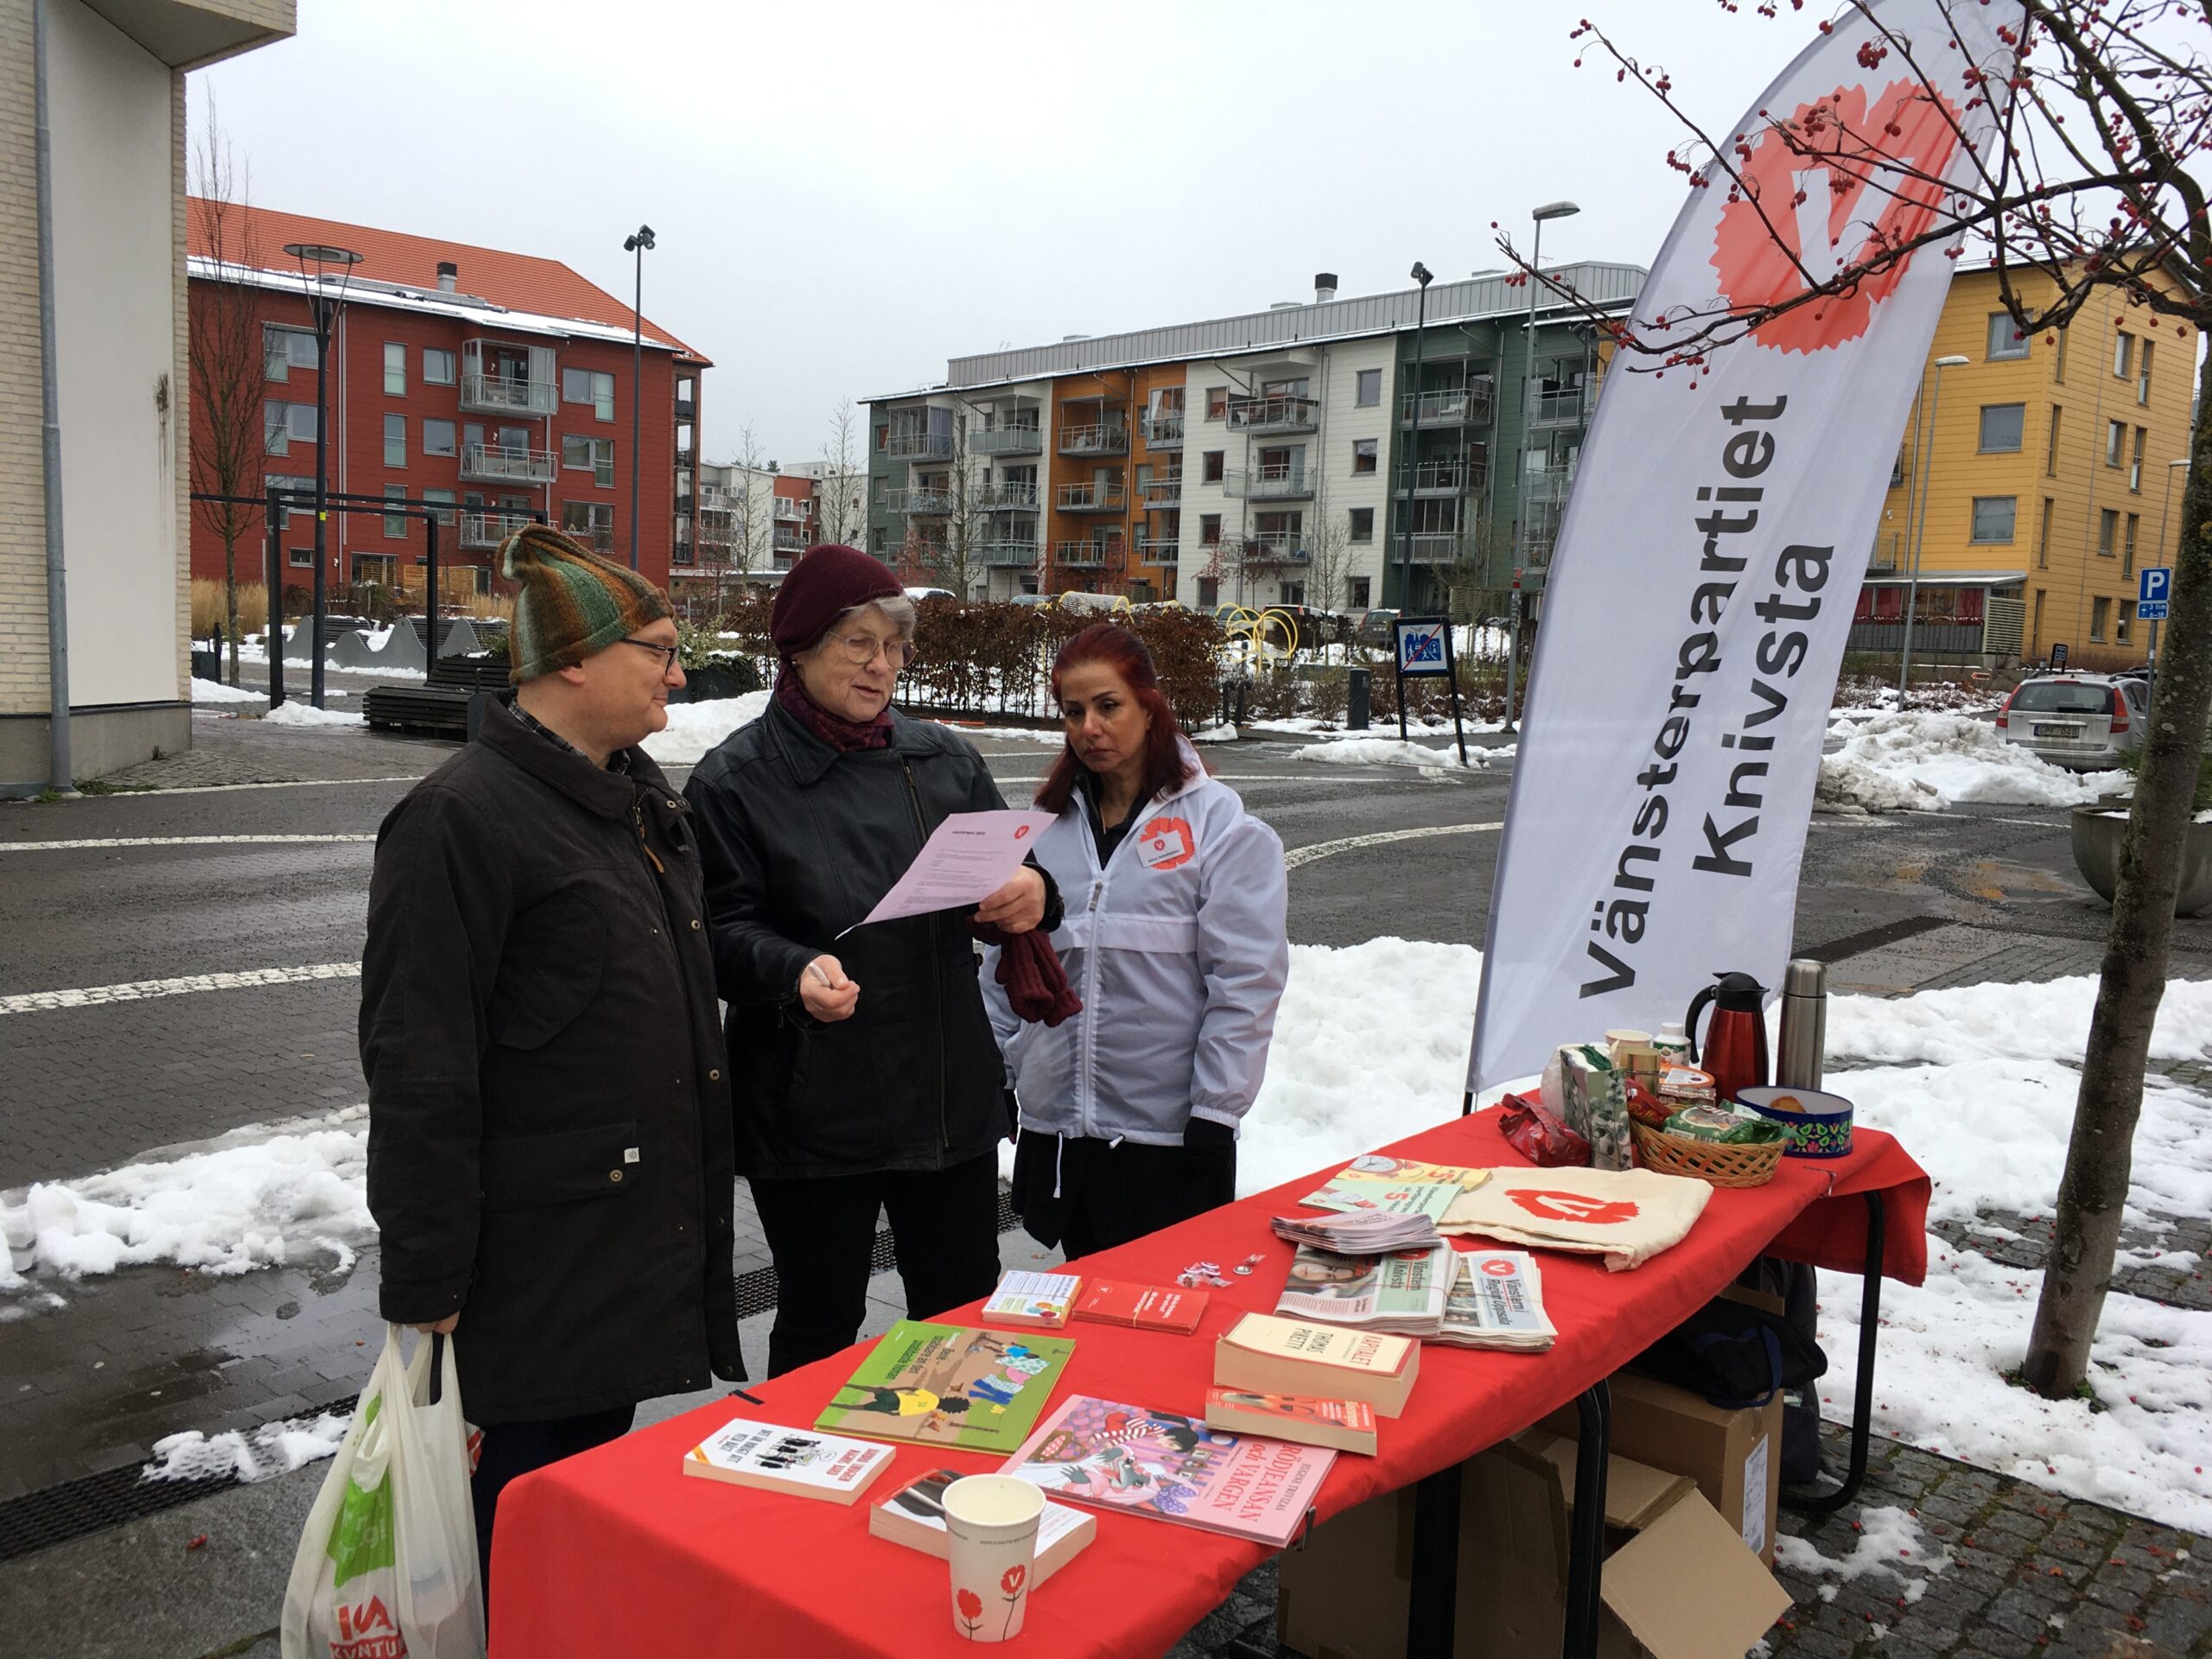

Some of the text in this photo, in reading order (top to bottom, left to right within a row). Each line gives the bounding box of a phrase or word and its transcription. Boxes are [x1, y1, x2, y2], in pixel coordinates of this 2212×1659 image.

[1791, 156, 1916, 289] V
[2146, 571, 2165, 599] P
[1579, 393, 1788, 1000] Vänsterpartiet
[1693, 543, 1834, 877] Knivsta
[1535, 1193, 1608, 1218] V
[1390, 1264, 1408, 1289] Knivsta
[1487, 1262, 1506, 1274] V
[1485, 1278, 1511, 1325] Region Uppsala
[1504, 1278, 1525, 1310] Vänstern
[919, 1335, 945, 1357] snabbare
[1284, 1329, 1313, 1350] PIKETTY
[1306, 1332, 1335, 1354] THOMAS
[1349, 1335, 1384, 1366] KAPITALET
[1244, 1443, 1267, 1463] och
[1211, 1460, 1257, 1512] VARGEN
[1236, 1444, 1302, 1522] RÖDJEANSAN
[1275, 1464, 1313, 1512] EUGENE TRIVIZAS
[1008, 1572, 1021, 1588] V
